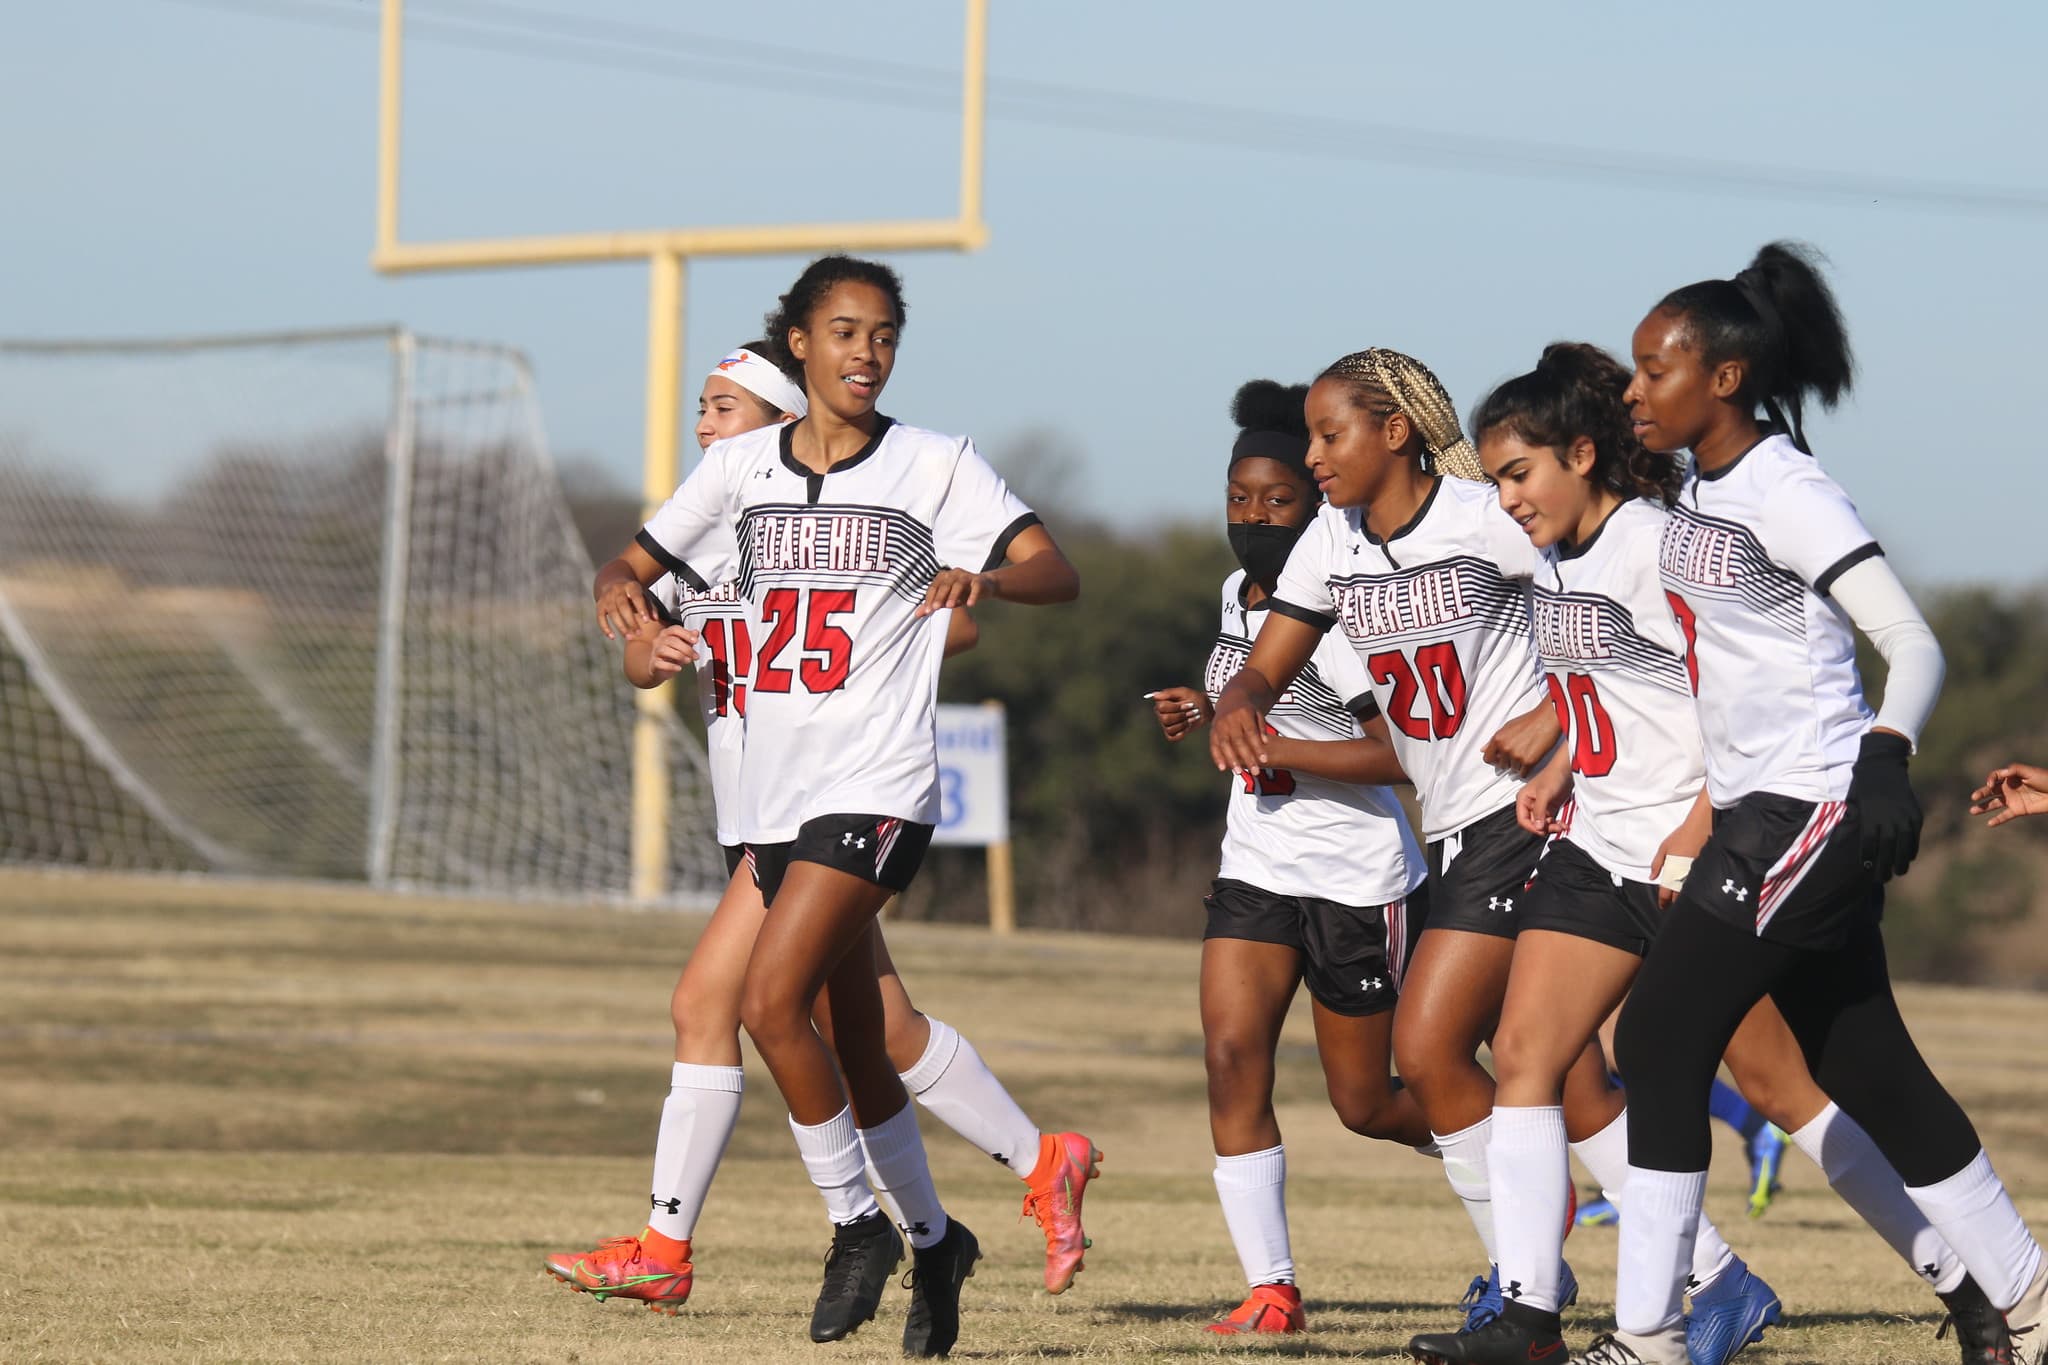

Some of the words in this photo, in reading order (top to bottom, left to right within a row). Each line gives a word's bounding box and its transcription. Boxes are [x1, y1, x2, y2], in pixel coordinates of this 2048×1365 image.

[752, 515, 817, 570] EDAR
[828, 516, 891, 572] HILL
[1683, 526, 1736, 588] HILL
[1407, 565, 1474, 629] HILL
[753, 588, 857, 694] 25
[1557, 603, 1612, 660] HILL
[1367, 640, 1467, 742] 20
